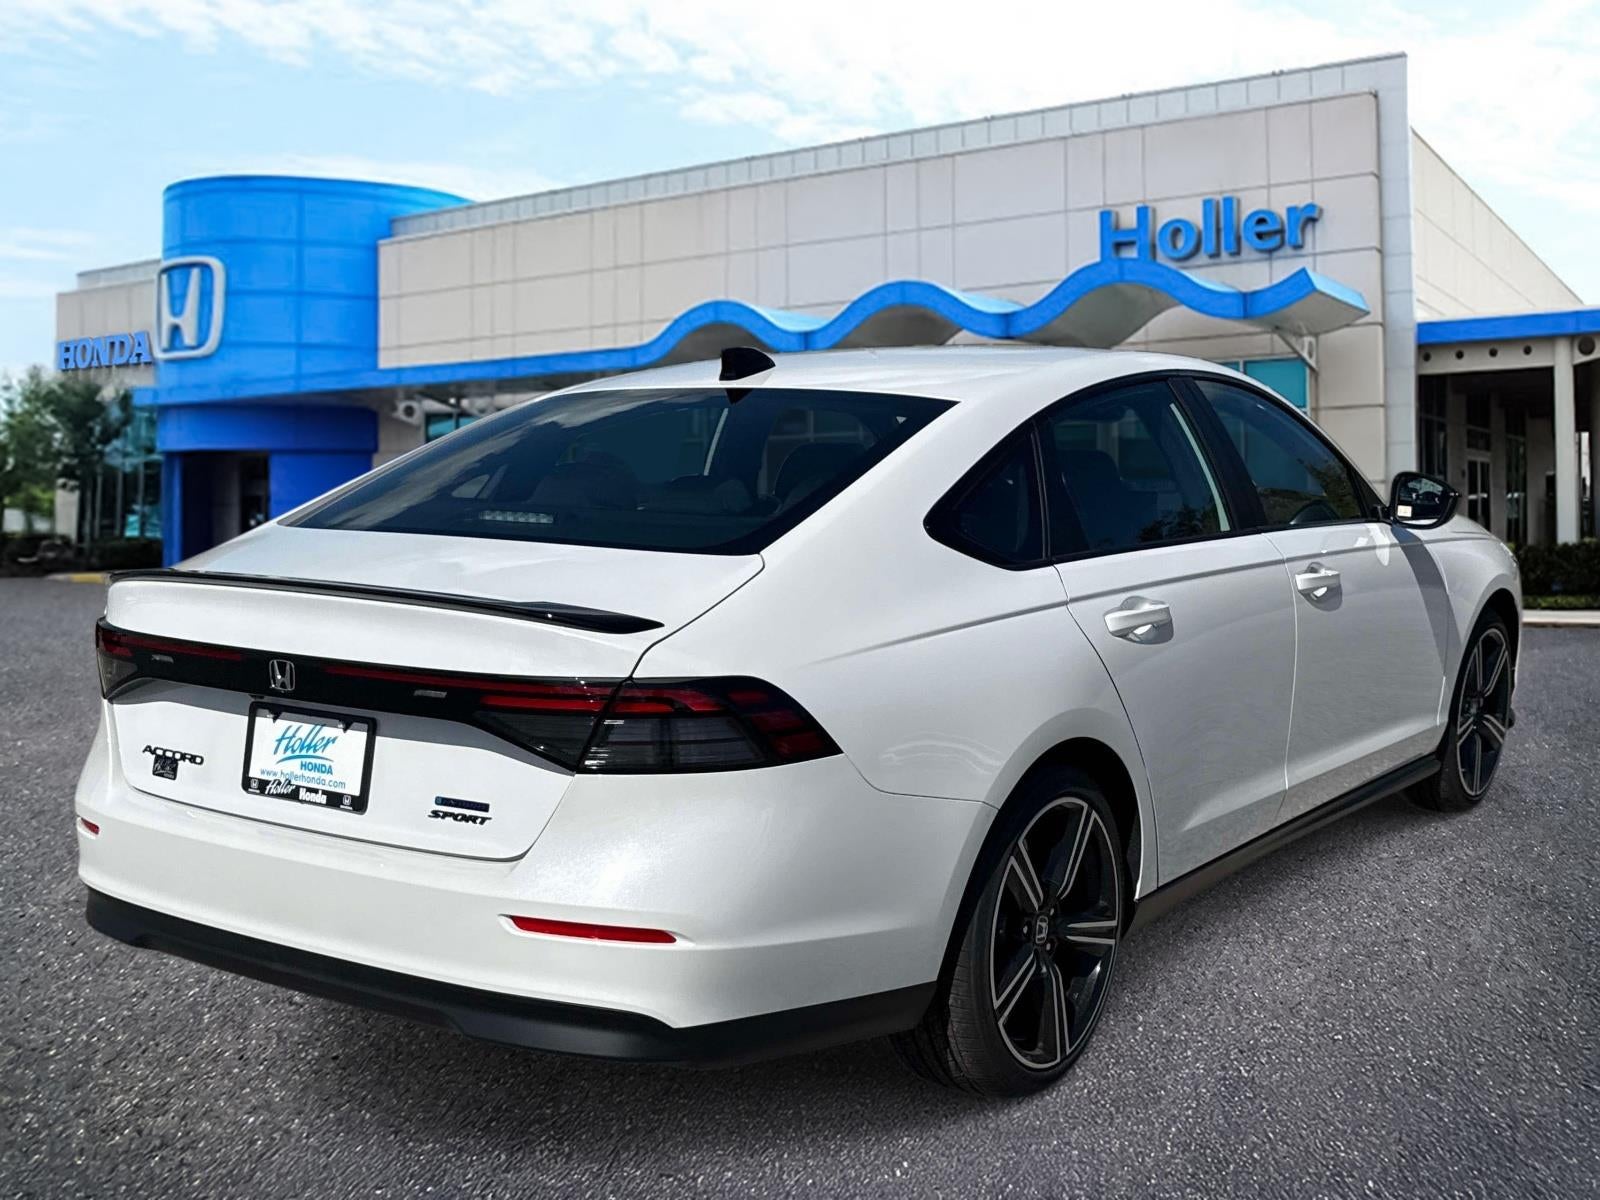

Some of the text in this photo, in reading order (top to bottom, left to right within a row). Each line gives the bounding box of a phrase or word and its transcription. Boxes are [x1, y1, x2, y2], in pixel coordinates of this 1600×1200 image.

[1099, 196, 1321, 262] Holler
[58, 331, 153, 371] HONDA
[273, 723, 339, 755] Holler
[143, 744, 205, 766] ACCORD
[260, 768, 346, 790] www.hollerhonda.com
[300, 761, 333, 776] HONDA
[265, 778, 327, 804] Holler Honda
[428, 809, 492, 826] SPORT
